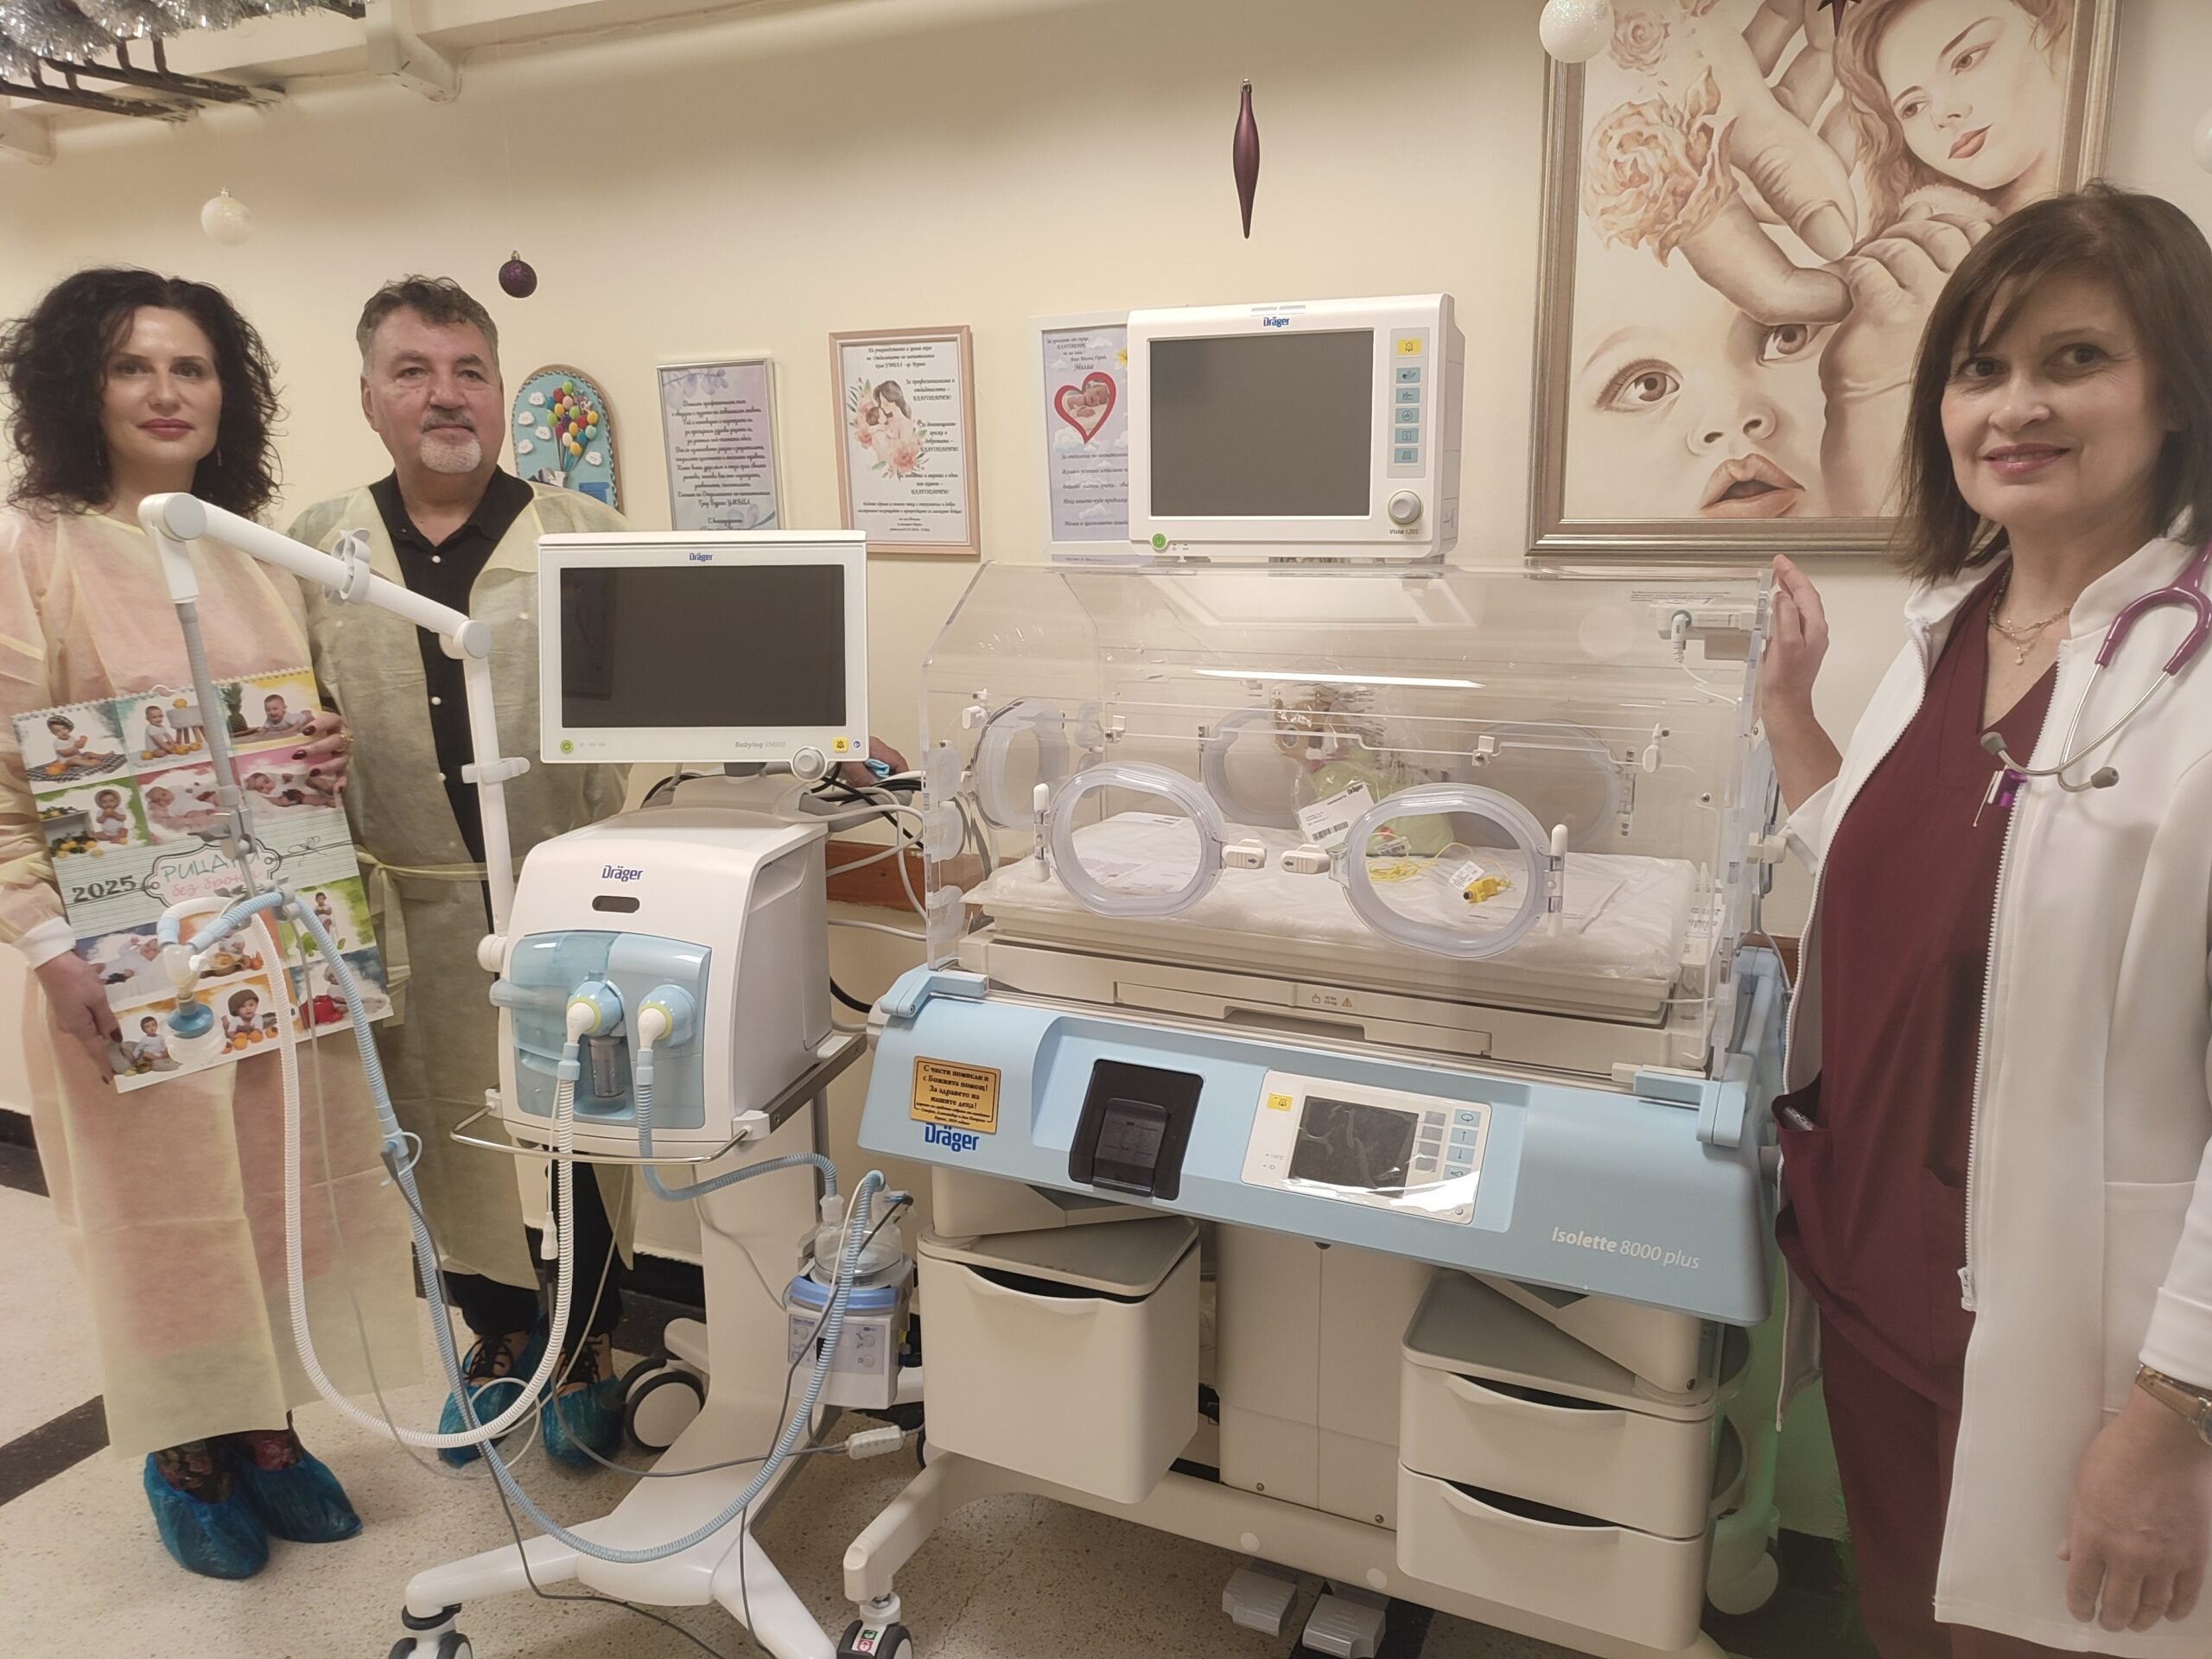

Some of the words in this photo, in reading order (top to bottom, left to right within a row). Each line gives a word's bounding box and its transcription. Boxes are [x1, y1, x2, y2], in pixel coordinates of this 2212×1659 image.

[1264, 316, 1290, 327] Dräger
[690, 553, 714, 563] Dräger
[735, 741, 764, 750] Babylog
[601, 865, 644, 882] Dräger
[73, 874, 137, 903] 2025
[925, 1122, 980, 1152] Dräger
[1552, 1227, 1618, 1253] Isolette
[1619, 1239, 1662, 1262] 8000
[1662, 1249, 1700, 1270] plus
